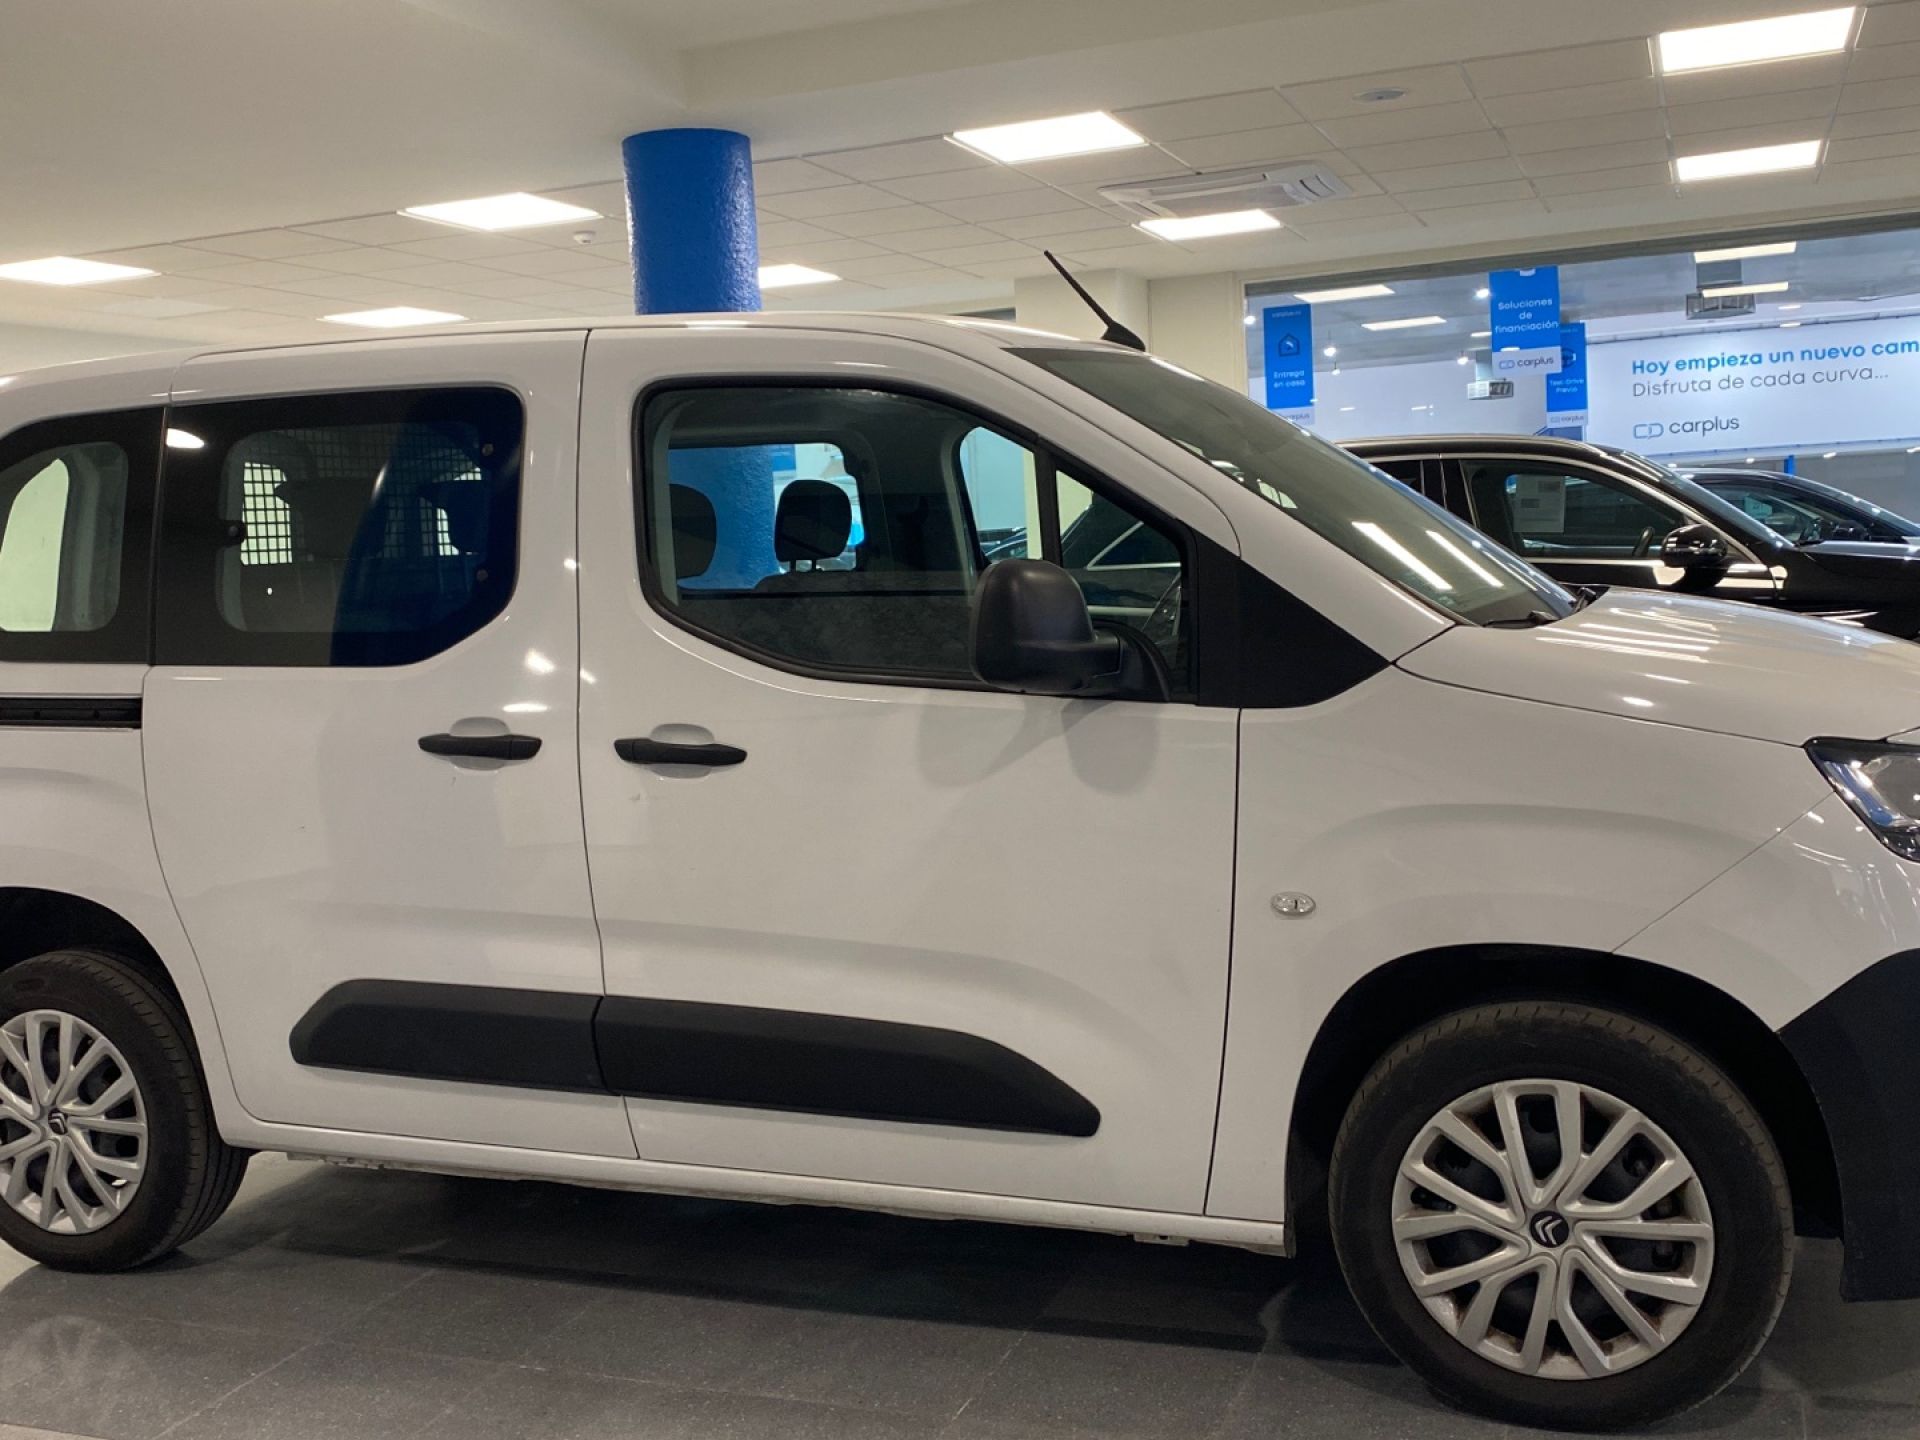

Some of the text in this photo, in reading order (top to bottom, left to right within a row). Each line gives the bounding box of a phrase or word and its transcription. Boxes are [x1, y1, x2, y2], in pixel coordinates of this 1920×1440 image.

[1498, 298, 1552, 310] Soluciones
[1519, 312, 1532, 320] de
[1495, 321, 1558, 333] financiación
[1517, 356, 1553, 368] carplus
[1632, 359, 1670, 376] Hoy
[1675, 352, 1763, 371] empieza
[1769, 350, 1794, 363] un
[1800, 345, 1865, 361] nuevo
[1273, 370, 1304, 379] Entrega
[1633, 367, 1889, 397] Disfruta de cada curva...
[1669, 416, 1740, 437] carplus
